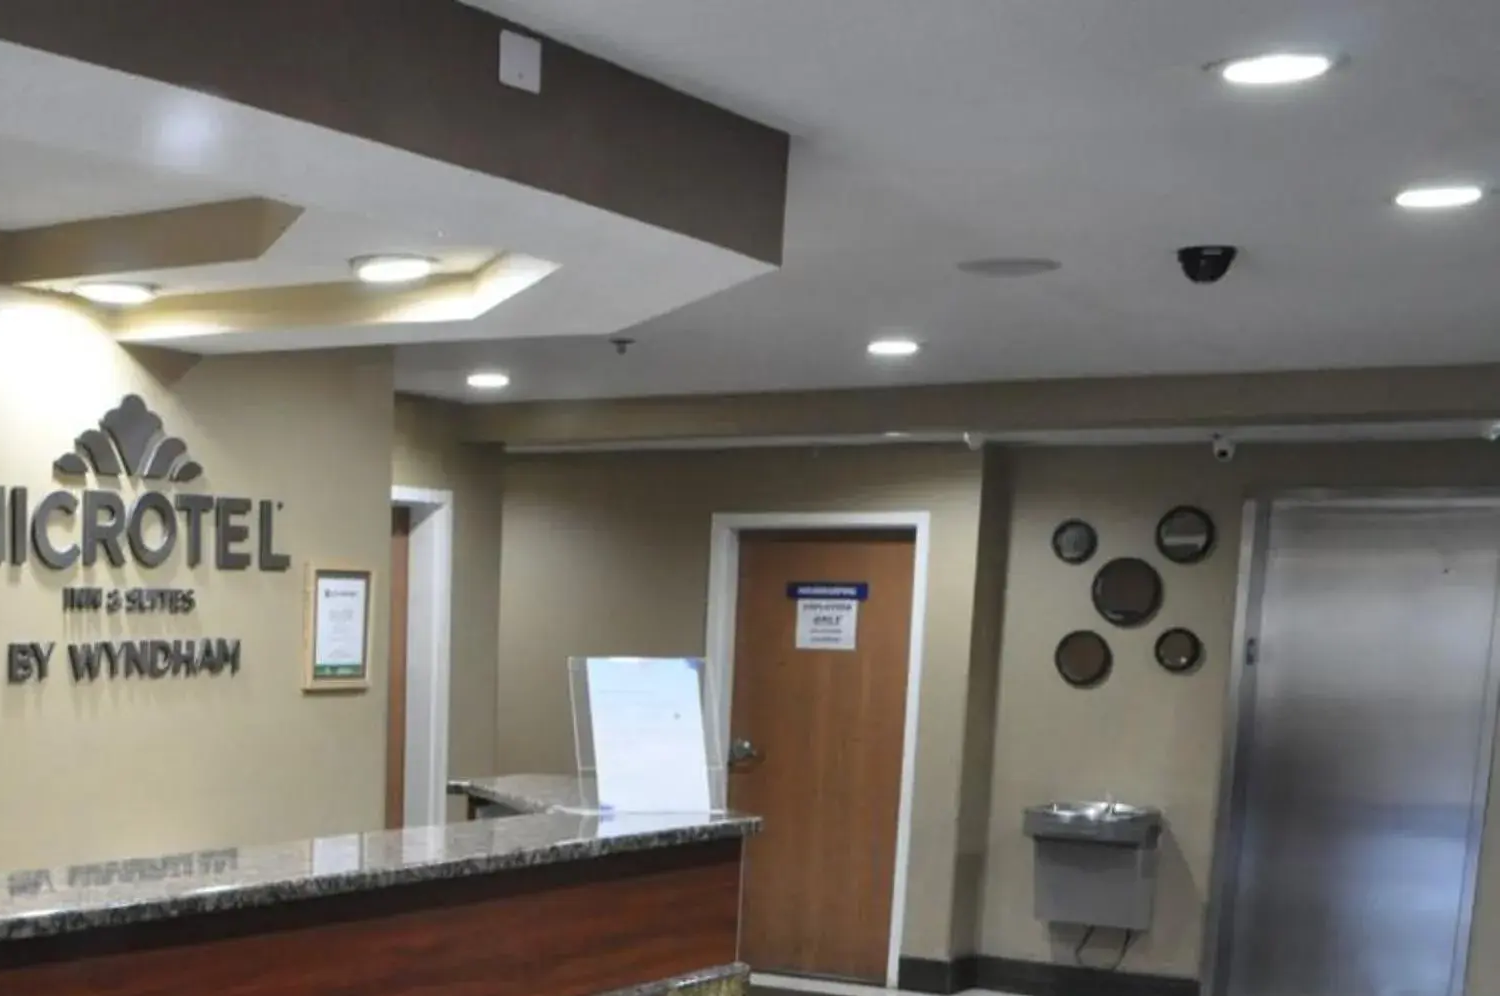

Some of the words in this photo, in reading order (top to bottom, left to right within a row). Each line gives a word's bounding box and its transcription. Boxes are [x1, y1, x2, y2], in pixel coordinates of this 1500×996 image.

[124, 588, 196, 615] SUITES
[6, 641, 56, 686] BY
[67, 638, 242, 684] WYNDHAM
